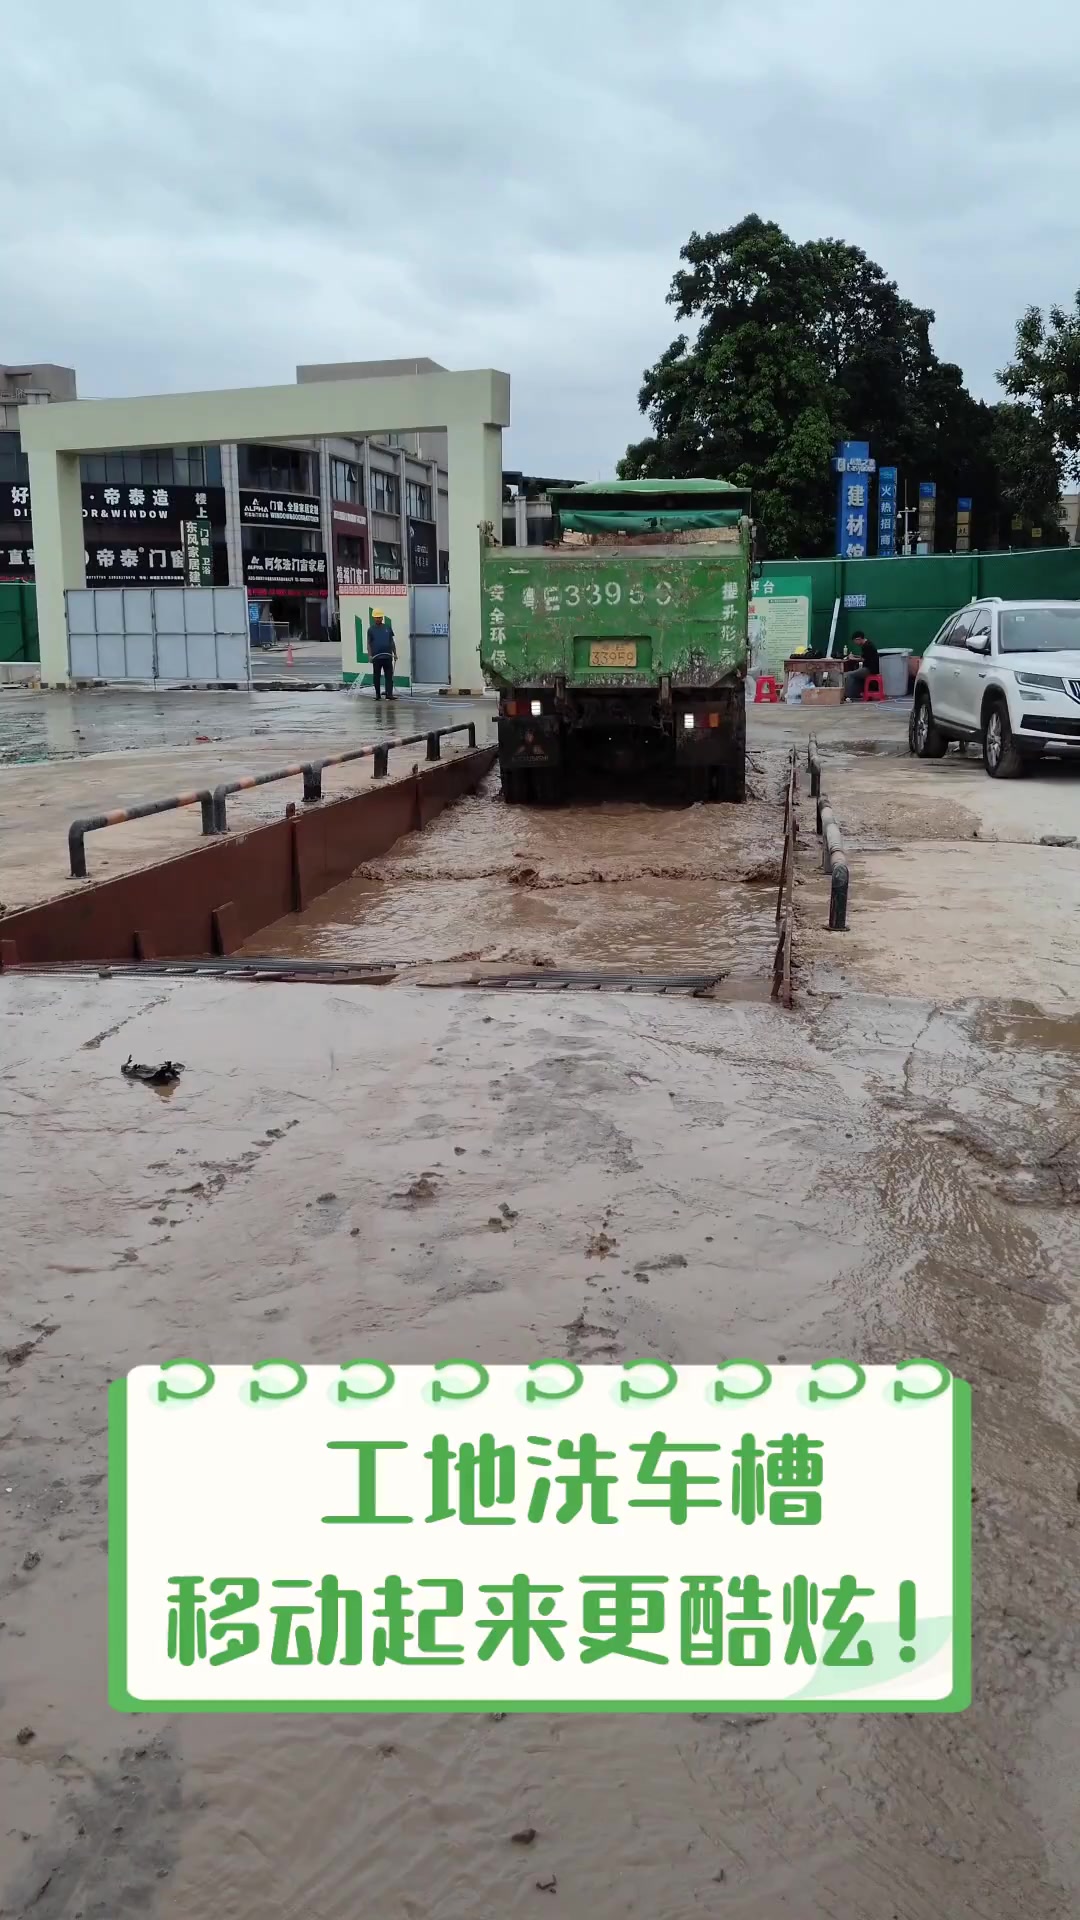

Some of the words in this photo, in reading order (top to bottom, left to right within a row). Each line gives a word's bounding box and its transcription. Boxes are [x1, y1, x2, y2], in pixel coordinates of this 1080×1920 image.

[11, 486, 29, 504] 好
[195, 492, 208, 519] 楼上
[880, 485, 892, 556] 火热招商
[0, 549, 35, 565] 直营
[489, 584, 507, 667] 安全环保
